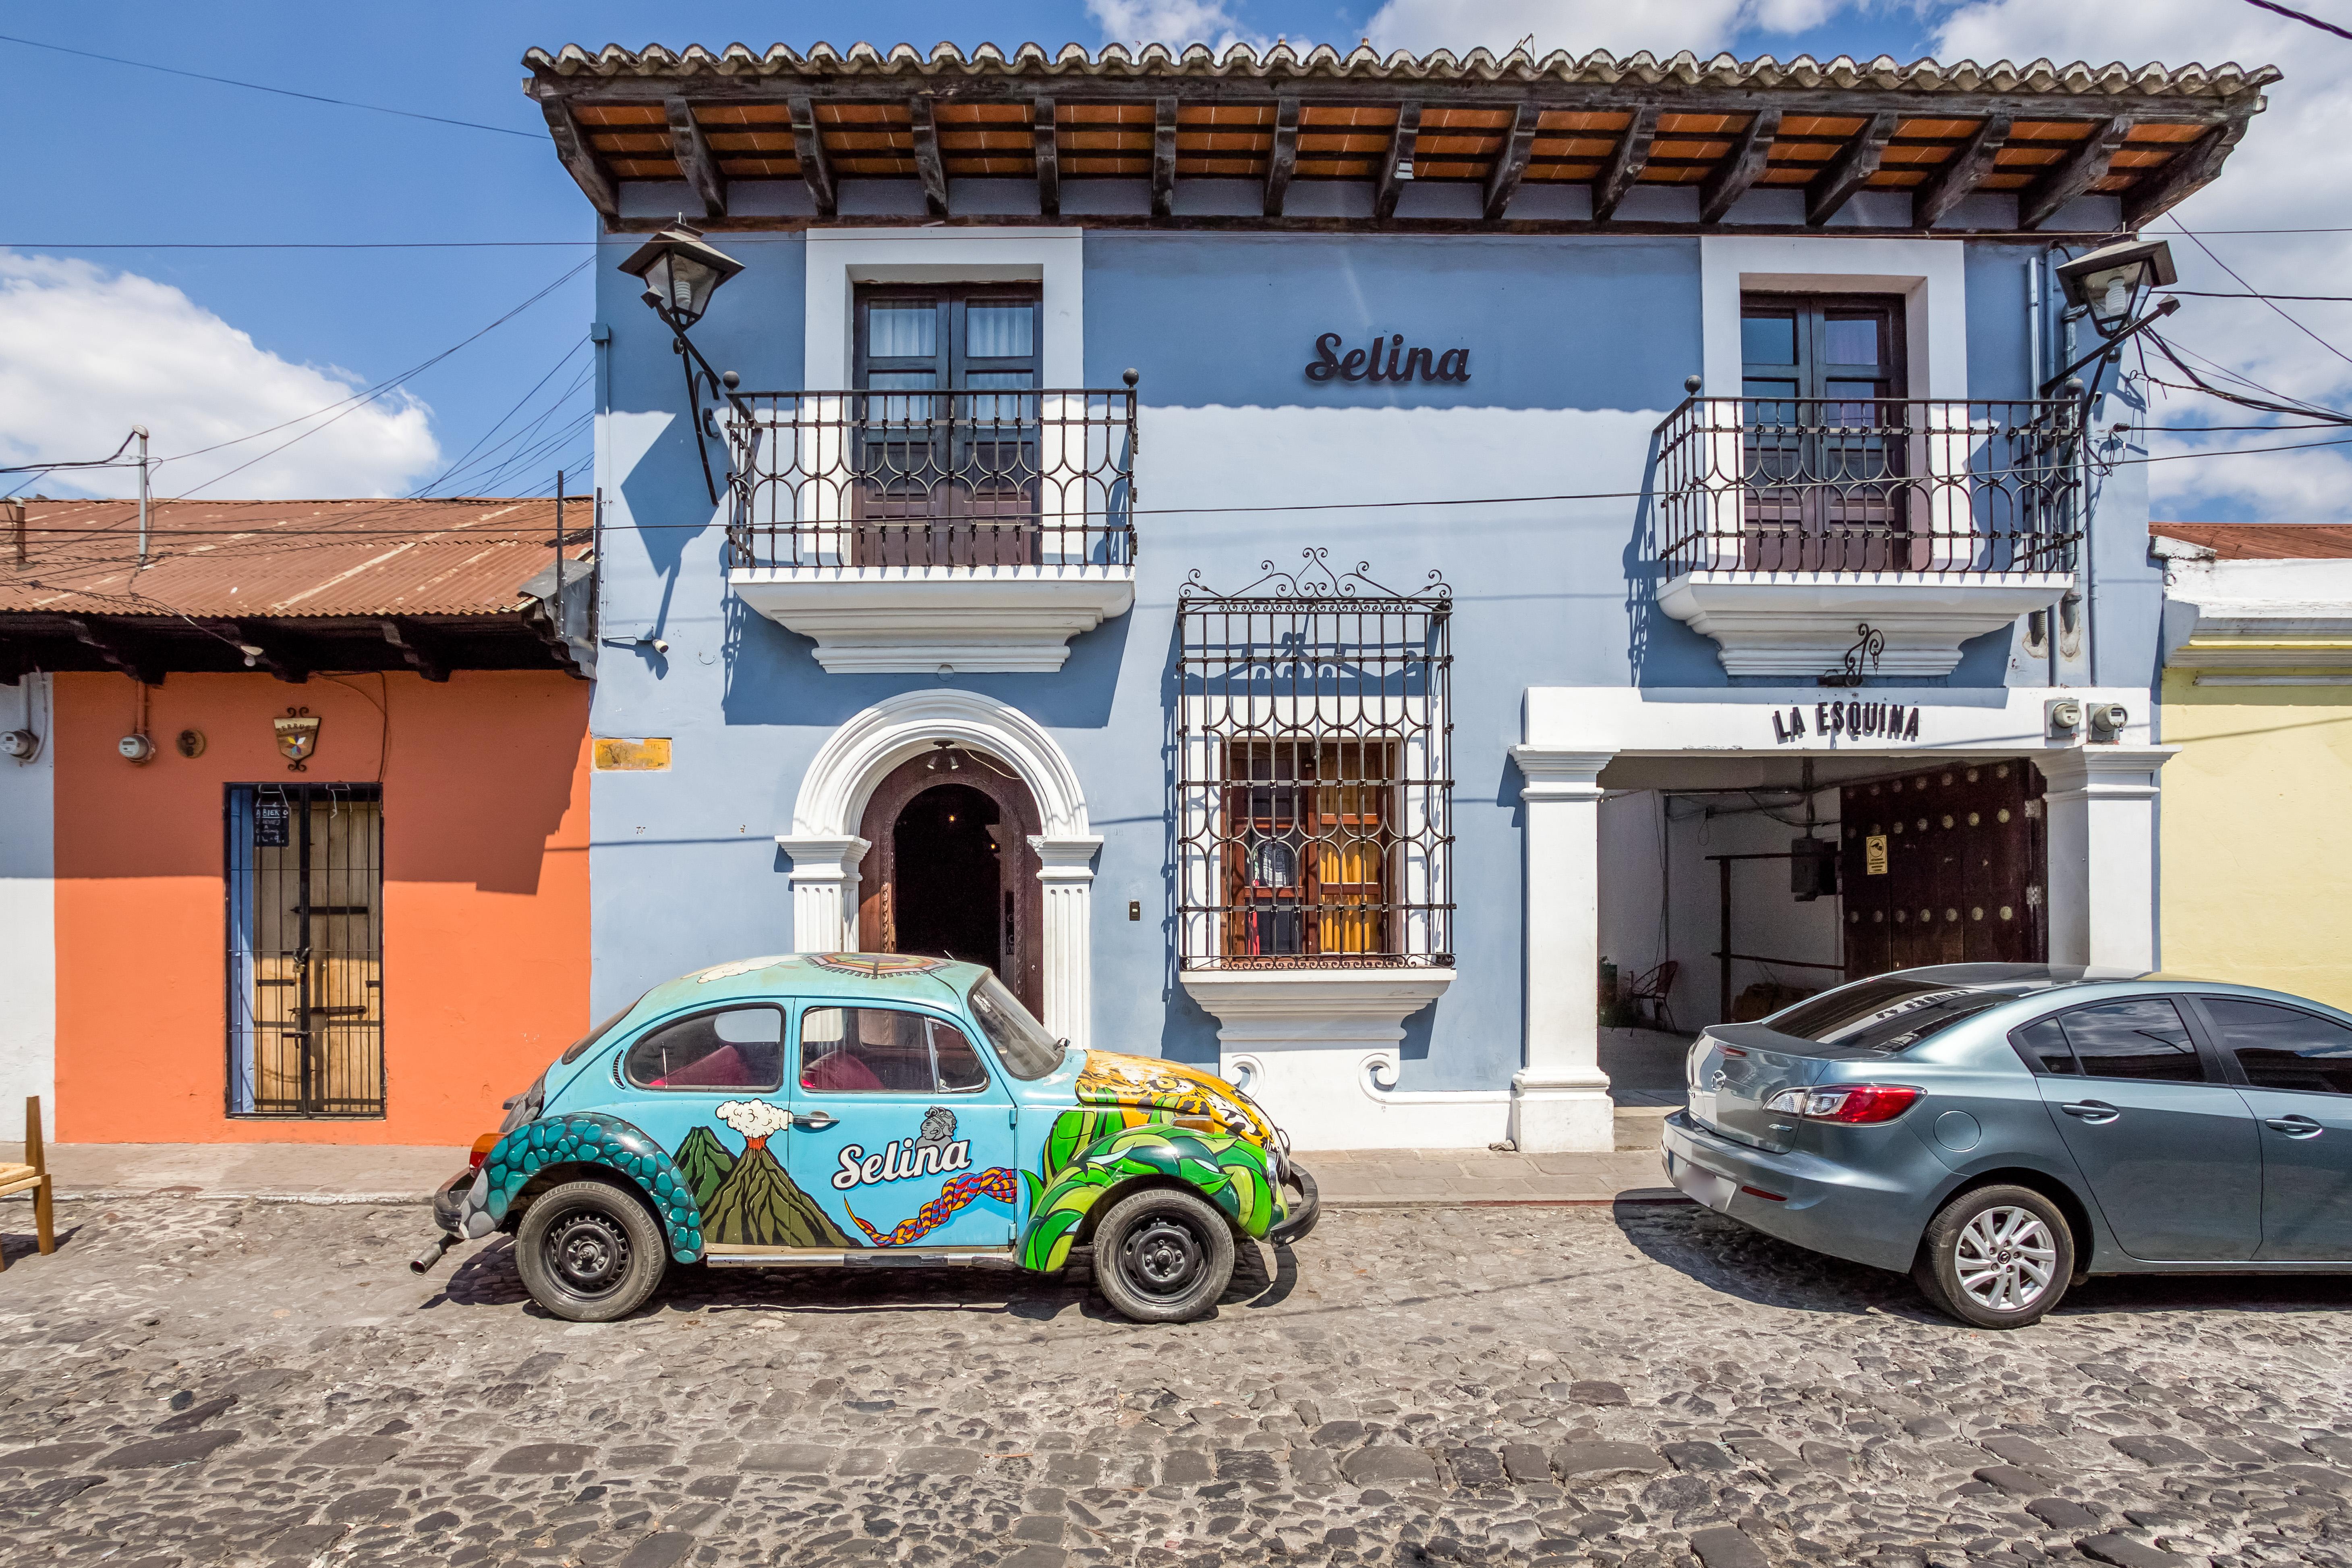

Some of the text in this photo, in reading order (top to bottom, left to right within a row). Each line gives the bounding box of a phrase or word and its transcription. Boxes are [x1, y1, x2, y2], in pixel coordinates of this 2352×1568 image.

[1305, 333, 1471, 382] Selina
[1774, 701, 1919, 738] LA ESQUINA
[256, 808, 288, 817] ABIERO
[831, 1137, 971, 1190] Selina
